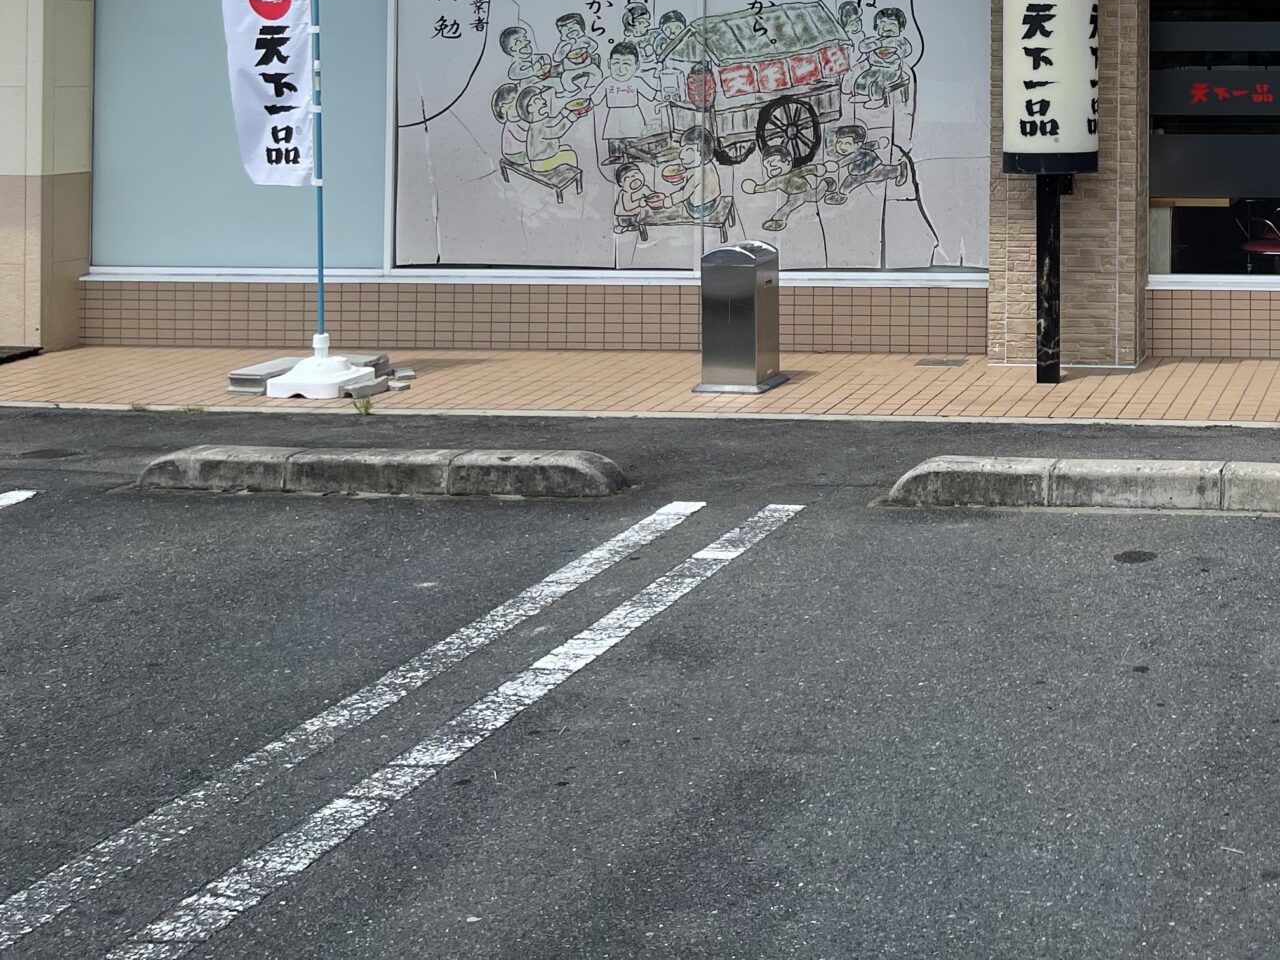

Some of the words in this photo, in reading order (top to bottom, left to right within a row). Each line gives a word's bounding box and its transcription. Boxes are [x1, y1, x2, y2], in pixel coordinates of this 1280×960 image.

[255, 26, 299, 165] 天下一品
[1020, 3, 1063, 137] 天下一品
[1190, 83, 1273, 103] 天下一品
